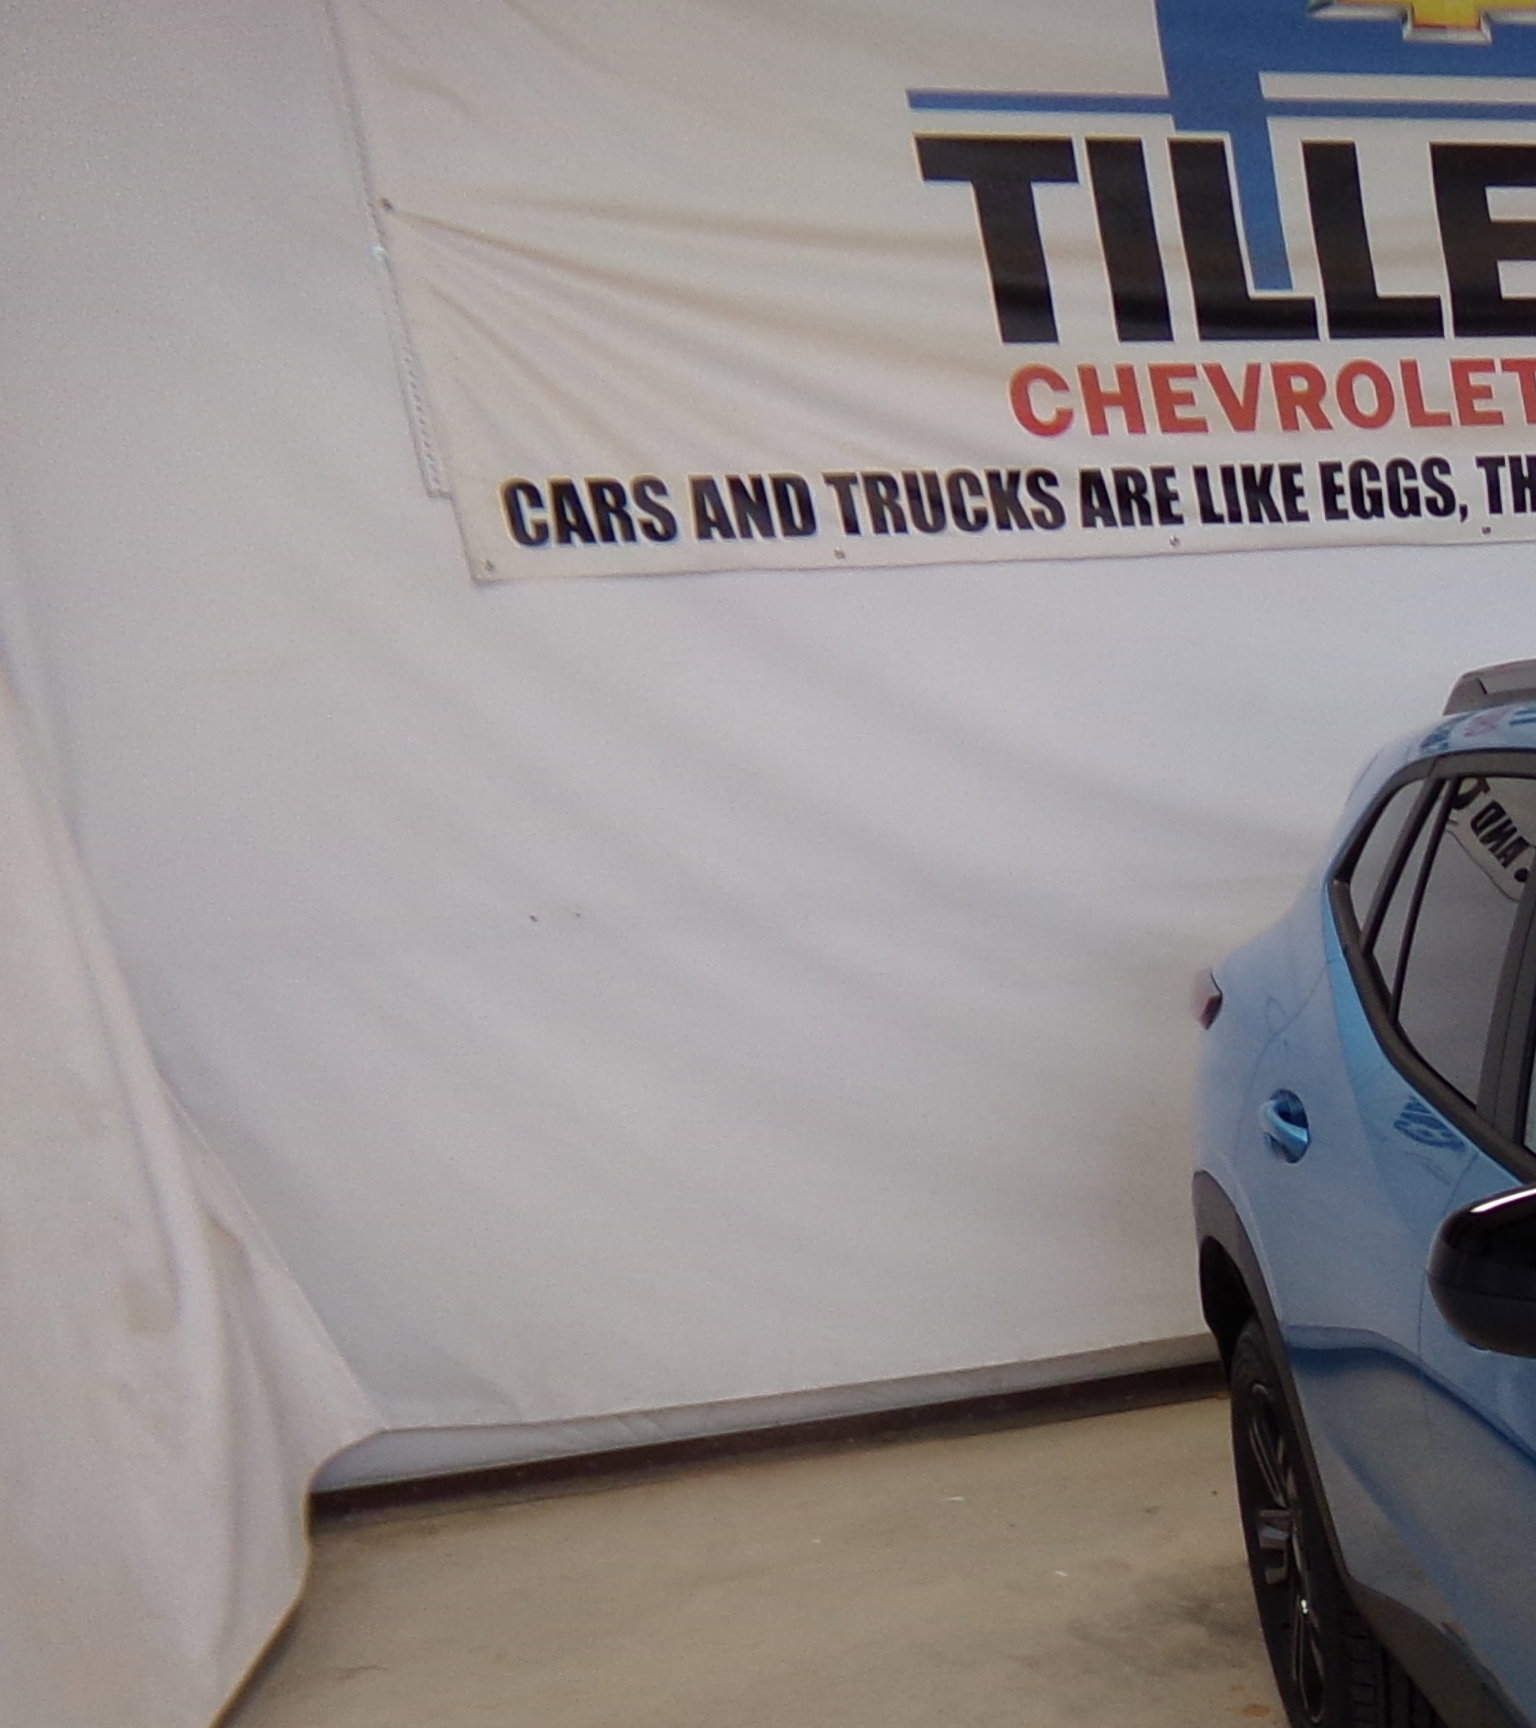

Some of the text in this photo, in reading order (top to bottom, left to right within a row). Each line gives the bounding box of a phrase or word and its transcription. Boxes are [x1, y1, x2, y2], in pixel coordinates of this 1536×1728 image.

[502, 473, 677, 547] CARS
[690, 471, 816, 540] AND
[823, 464, 1066, 535] TRUCKS
[1077, 462, 1184, 528] ARE
[1192, 460, 1310, 525] LIKE
[1319, 456, 1469, 524] EGGS,
